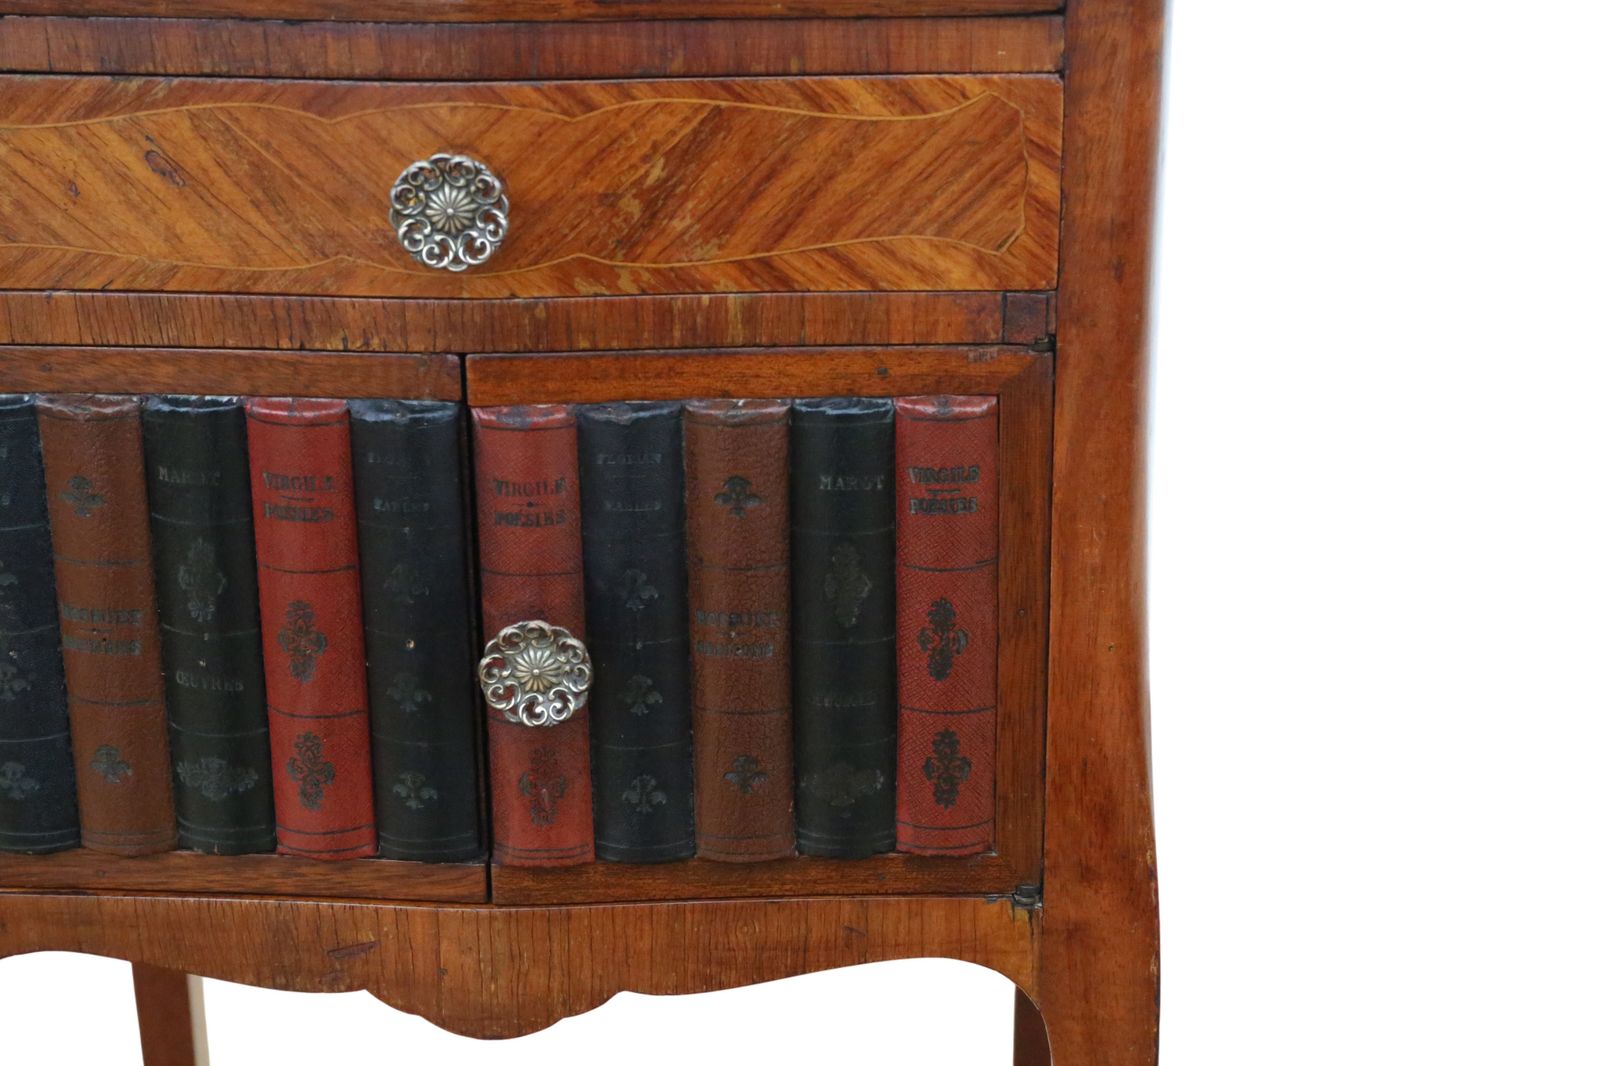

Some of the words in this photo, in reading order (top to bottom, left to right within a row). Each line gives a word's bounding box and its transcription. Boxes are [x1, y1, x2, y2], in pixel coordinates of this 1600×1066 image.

[261, 472, 336, 493] VIRGILE
[818, 473, 886, 491] MAROT
[907, 464, 980, 486] VIRGILE
[492, 477, 567, 498] VIRGILE
